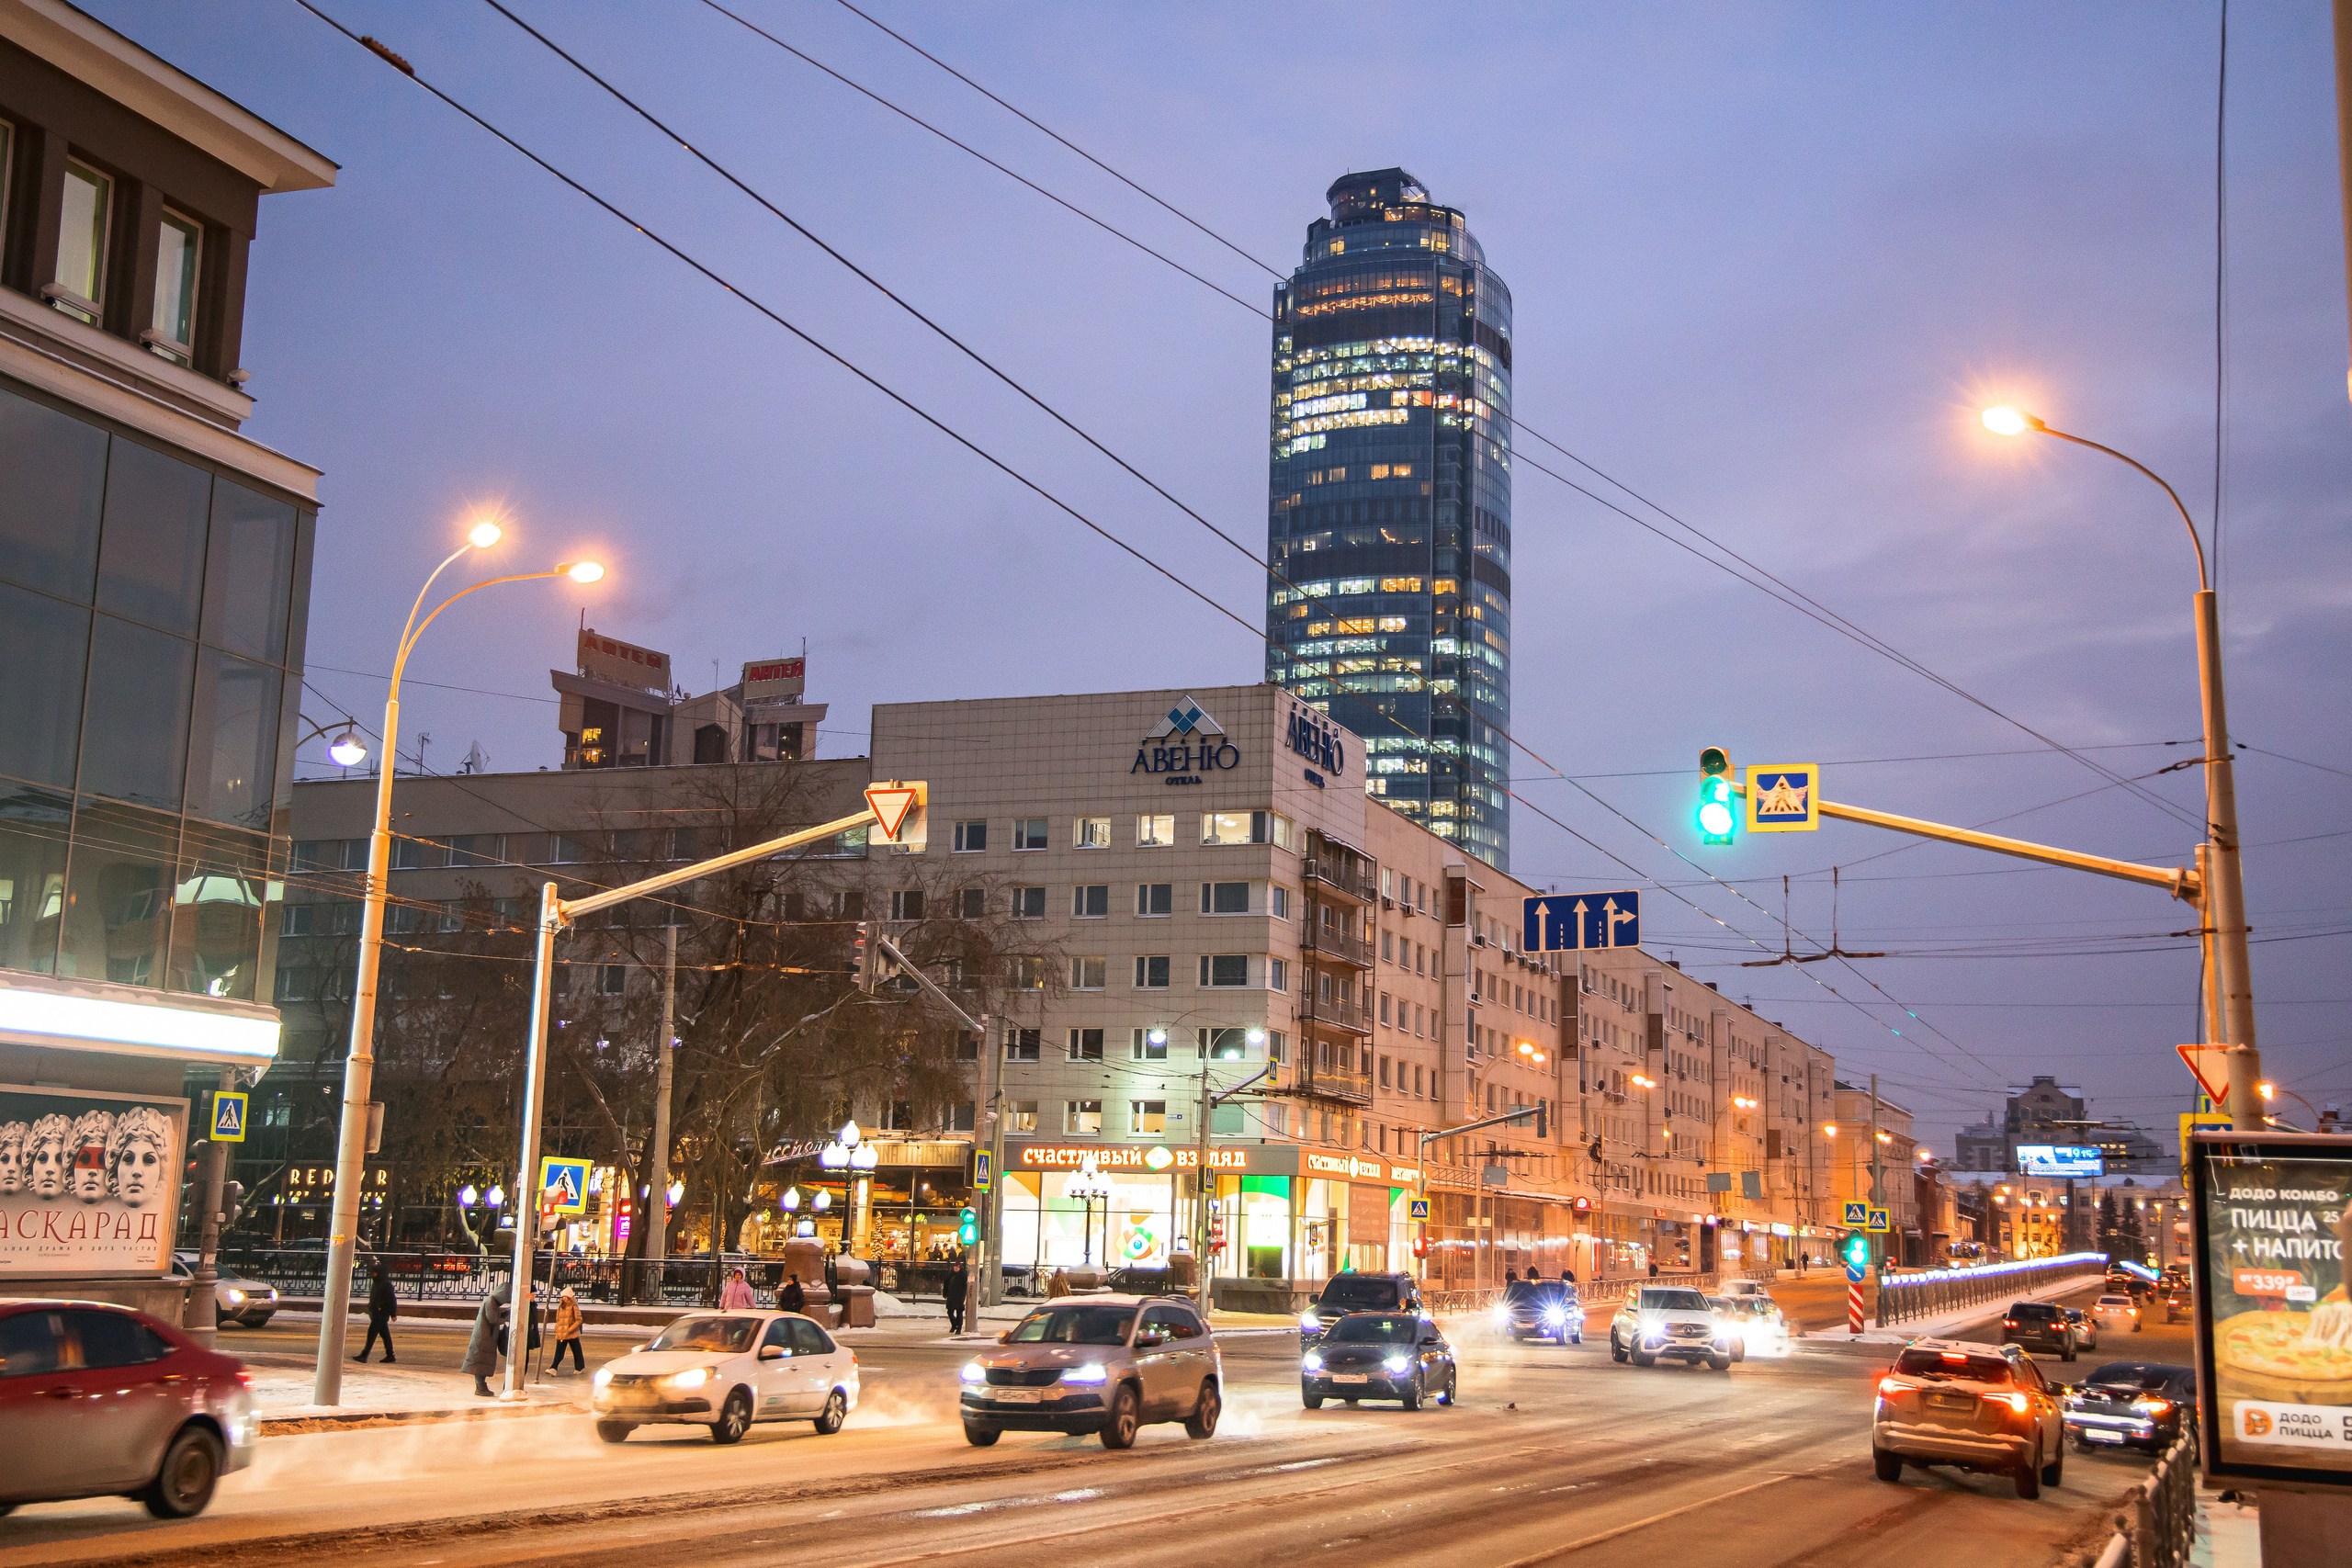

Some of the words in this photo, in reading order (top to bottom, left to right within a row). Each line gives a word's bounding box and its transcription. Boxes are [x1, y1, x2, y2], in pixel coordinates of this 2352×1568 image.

[584, 636, 662, 670] АНТЕЙ
[748, 660, 803, 682] АНТЕЙ
[1285, 711, 1344, 776] АВЕНЮ
[1130, 742, 1239, 773] АВЕНЮ
[1023, 1146, 1143, 1167] счастливый
[1176, 1150, 1247, 1168] взляд
[2229, 1188, 2277, 1201] ДОДО
[2279, 1189, 2338, 1201] КОМБО
[2232, 1208, 2317, 1234] ПИЦЦА
[2323, 1211, 2339, 1223] 25
[2279, 1413, 2322, 1425] ДОДО
[2278, 1426, 2334, 1439] ПИЦЦА
